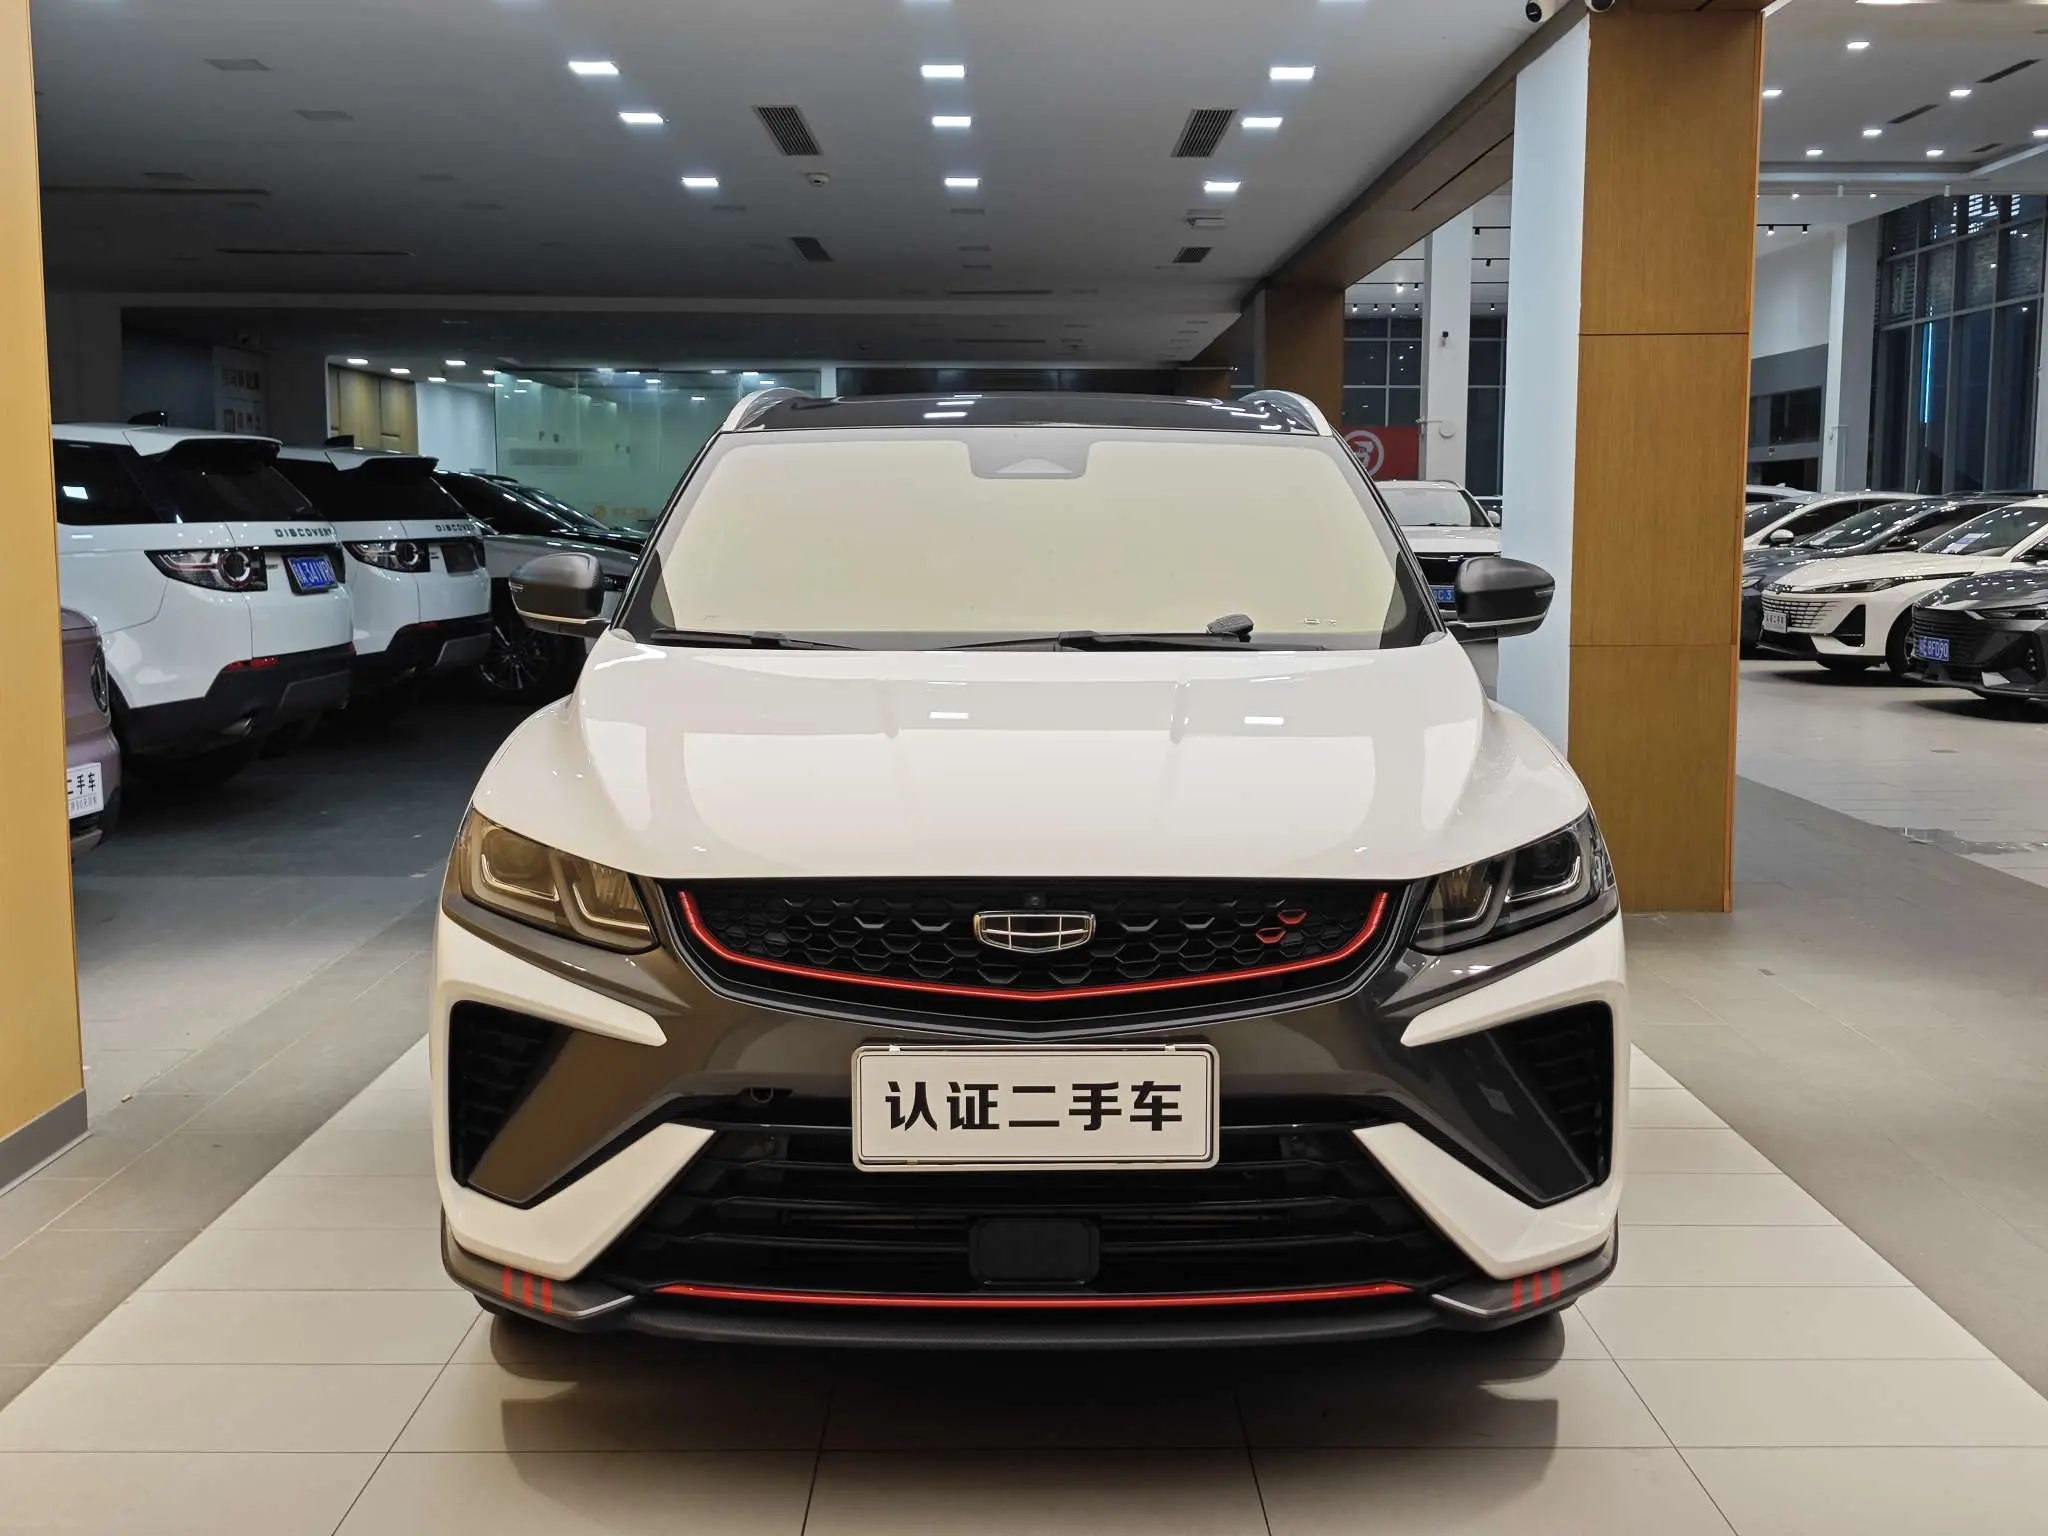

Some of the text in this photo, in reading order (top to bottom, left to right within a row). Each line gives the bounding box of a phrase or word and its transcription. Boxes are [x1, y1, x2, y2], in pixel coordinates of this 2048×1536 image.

[885, 1080, 1183, 1132] 认证二手车
